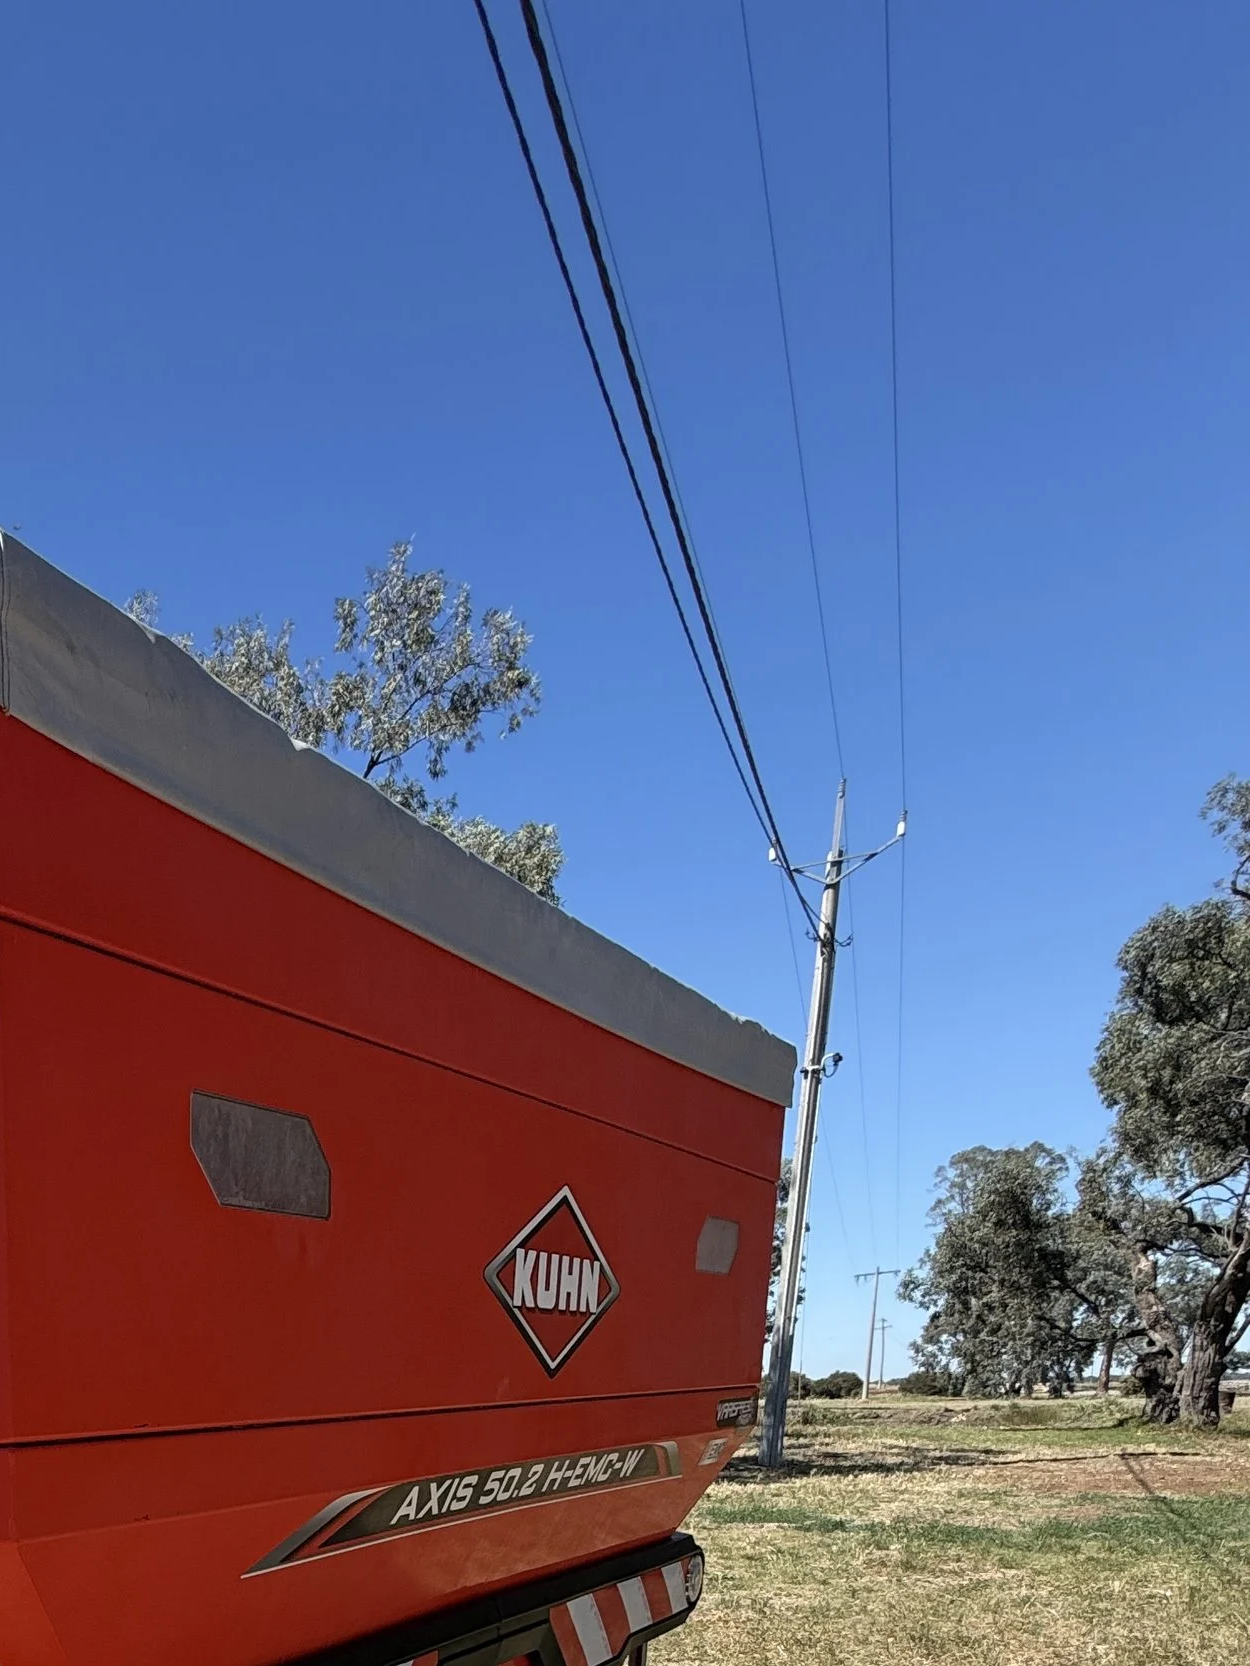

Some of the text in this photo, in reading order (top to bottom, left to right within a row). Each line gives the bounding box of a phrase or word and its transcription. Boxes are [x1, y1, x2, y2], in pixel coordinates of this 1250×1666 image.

[513, 1248, 600, 1313] KUHN
[390, 1449, 645, 1525] AXIS 50.2 H-EMC-W
